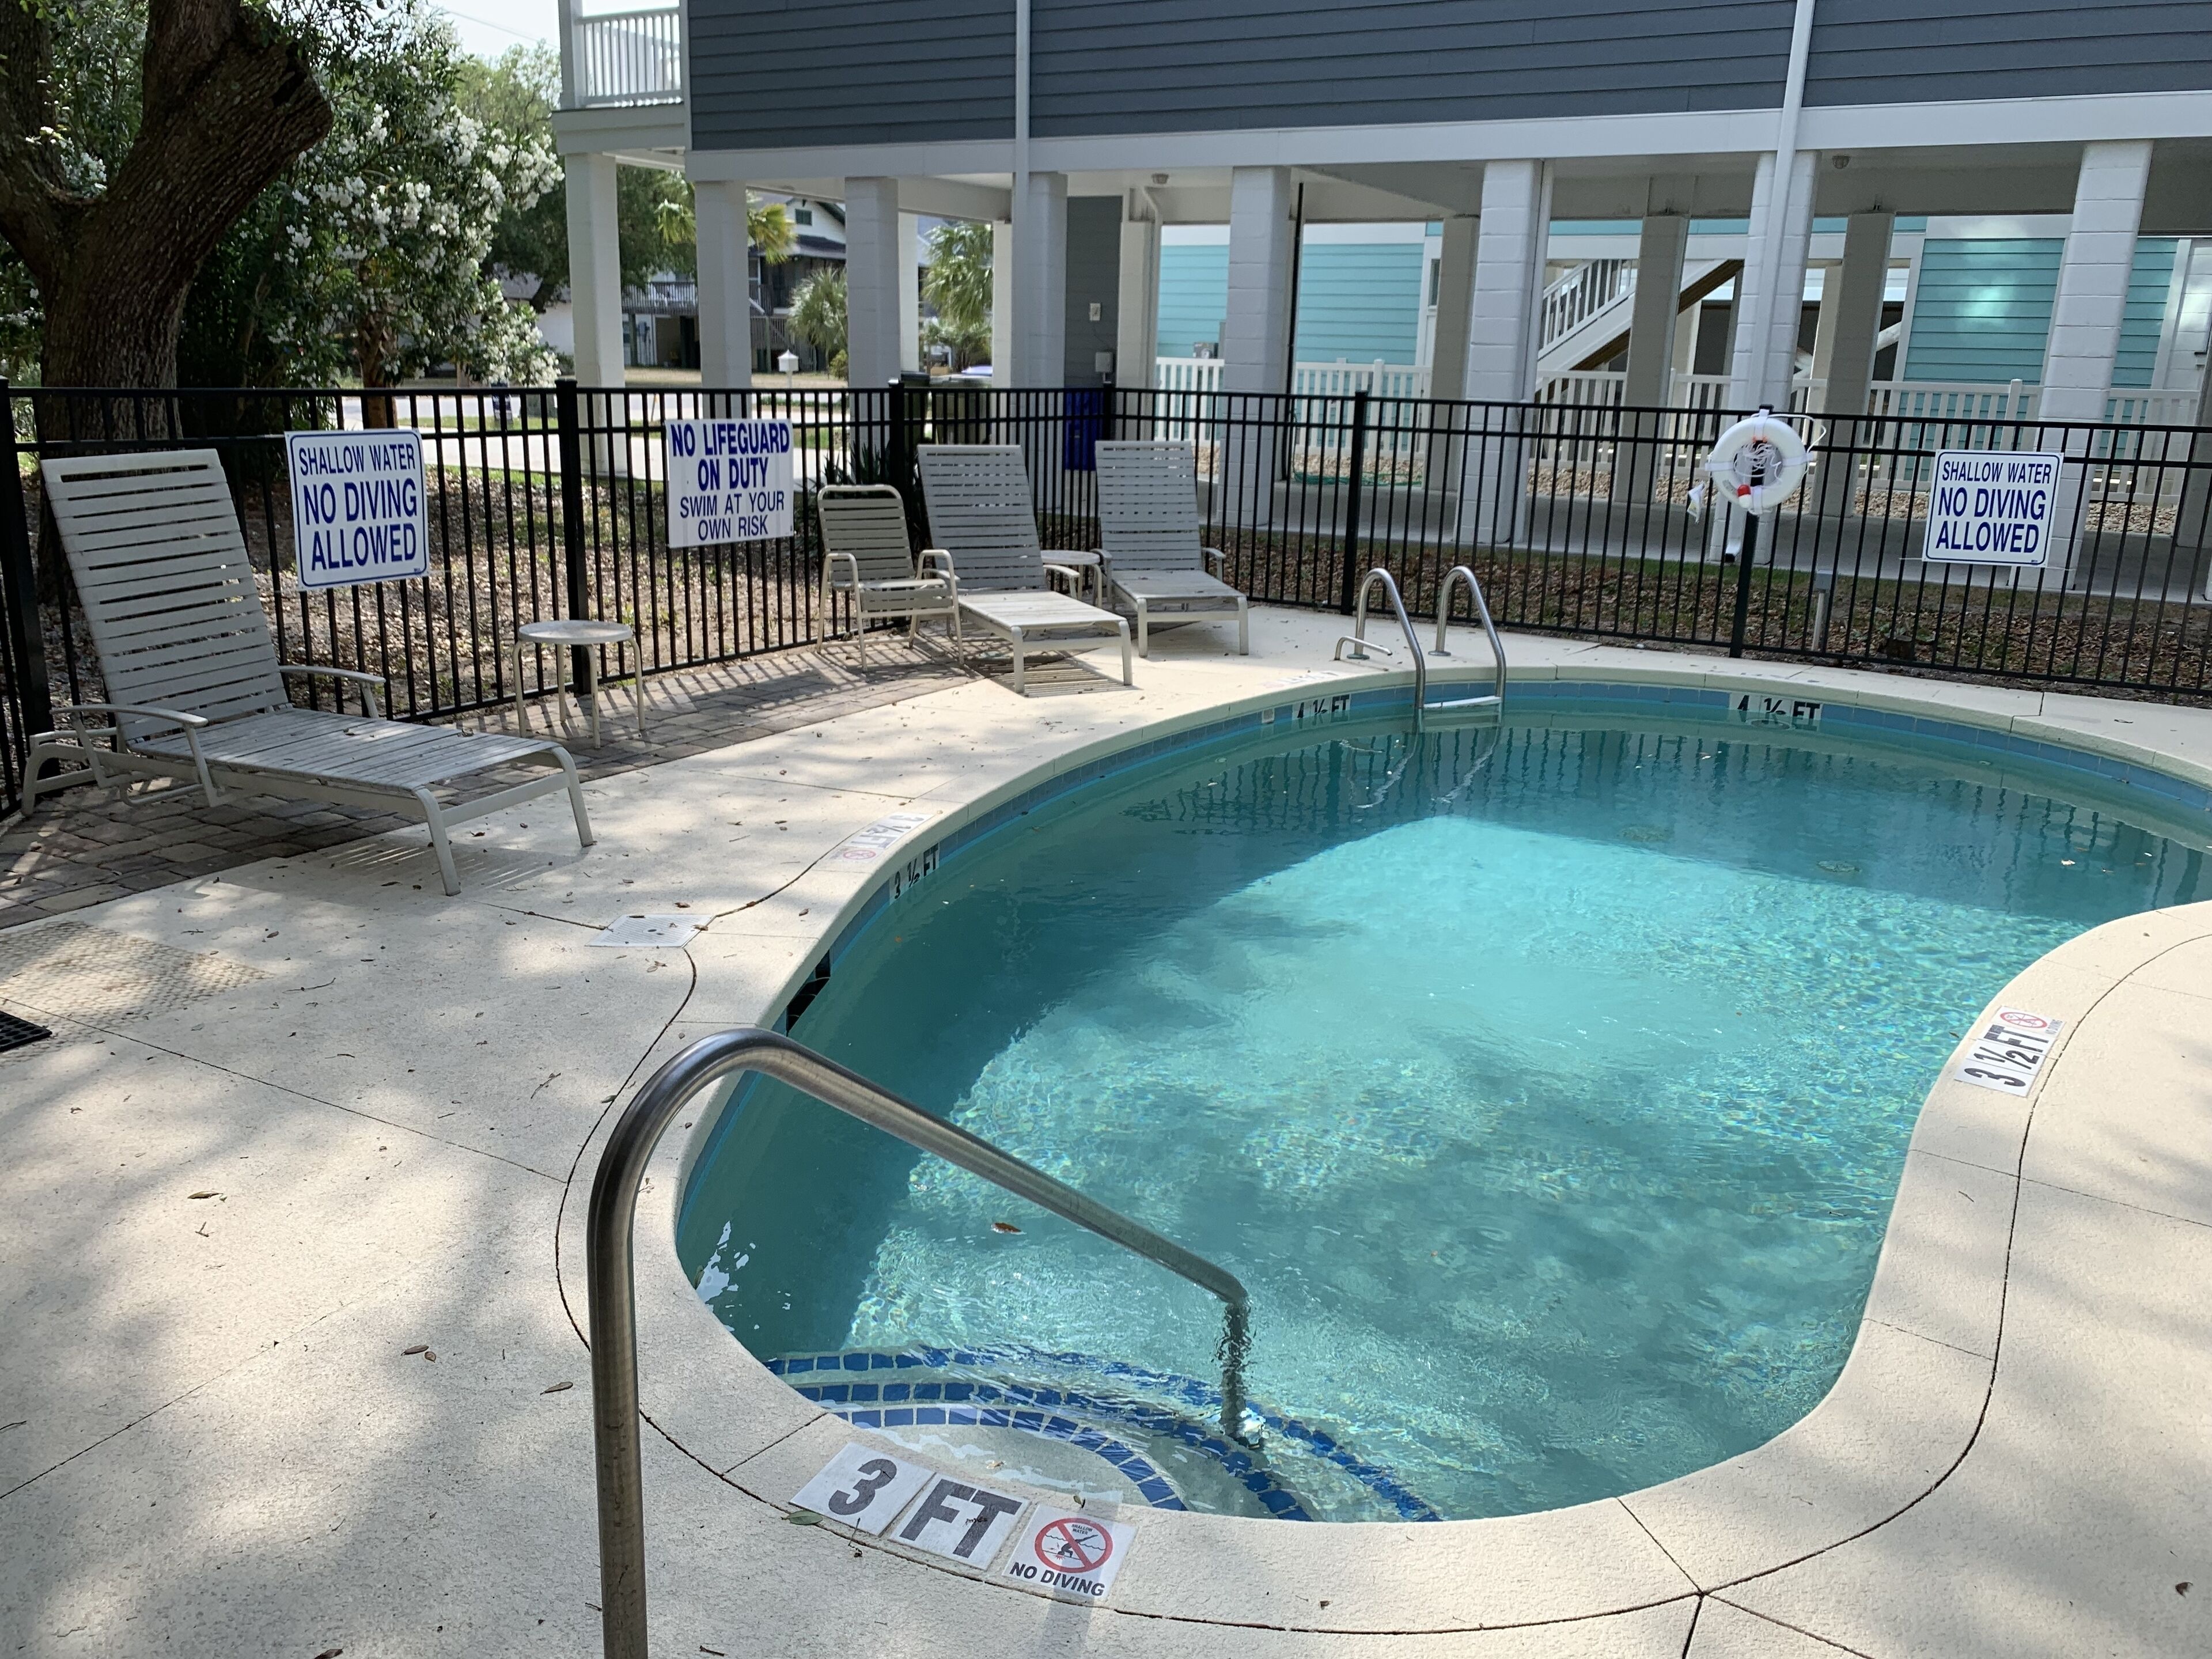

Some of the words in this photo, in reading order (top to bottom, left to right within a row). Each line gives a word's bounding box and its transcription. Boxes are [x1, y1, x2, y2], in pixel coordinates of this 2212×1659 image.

[671, 423, 695, 457] NO
[703, 423, 790, 455] LIFEGUARD
[299, 445, 364, 476] SHALLOW
[369, 444, 415, 471] WATER
[698, 459, 720, 491] ON
[729, 457, 768, 489] DUTY
[1942, 461, 2003, 482] SHALLOW
[2008, 463, 2052, 484] WATER
[304, 483, 336, 525] NO
[344, 478, 417, 521] DIVING
[680, 495, 717, 518] SWIM
[725, 493, 742, 515] AT
[749, 491, 784, 513] YOUR
[1938, 487, 1967, 517] NO
[1974, 488, 2046, 520] DIVING
[698, 517, 731, 541] OWN
[738, 514, 768, 537] RISK
[1936, 521, 2039, 553] ALLOWED
[312, 523, 416, 571] ALLOWED
[895, 871, 901, 900] 3
[923, 843, 939, 877] FT
[1984, 1025, 2049, 1053] FT
[1964, 1067, 2026, 1087] 3
[828, 1458, 897, 1515] 3
[899, 1478, 1023, 1559] FT
[1071, 1524, 1093, 1532] SHALLOW
[1009, 1562, 1037, 1579] NO
[1040, 1570, 1105, 1596] DIVING
